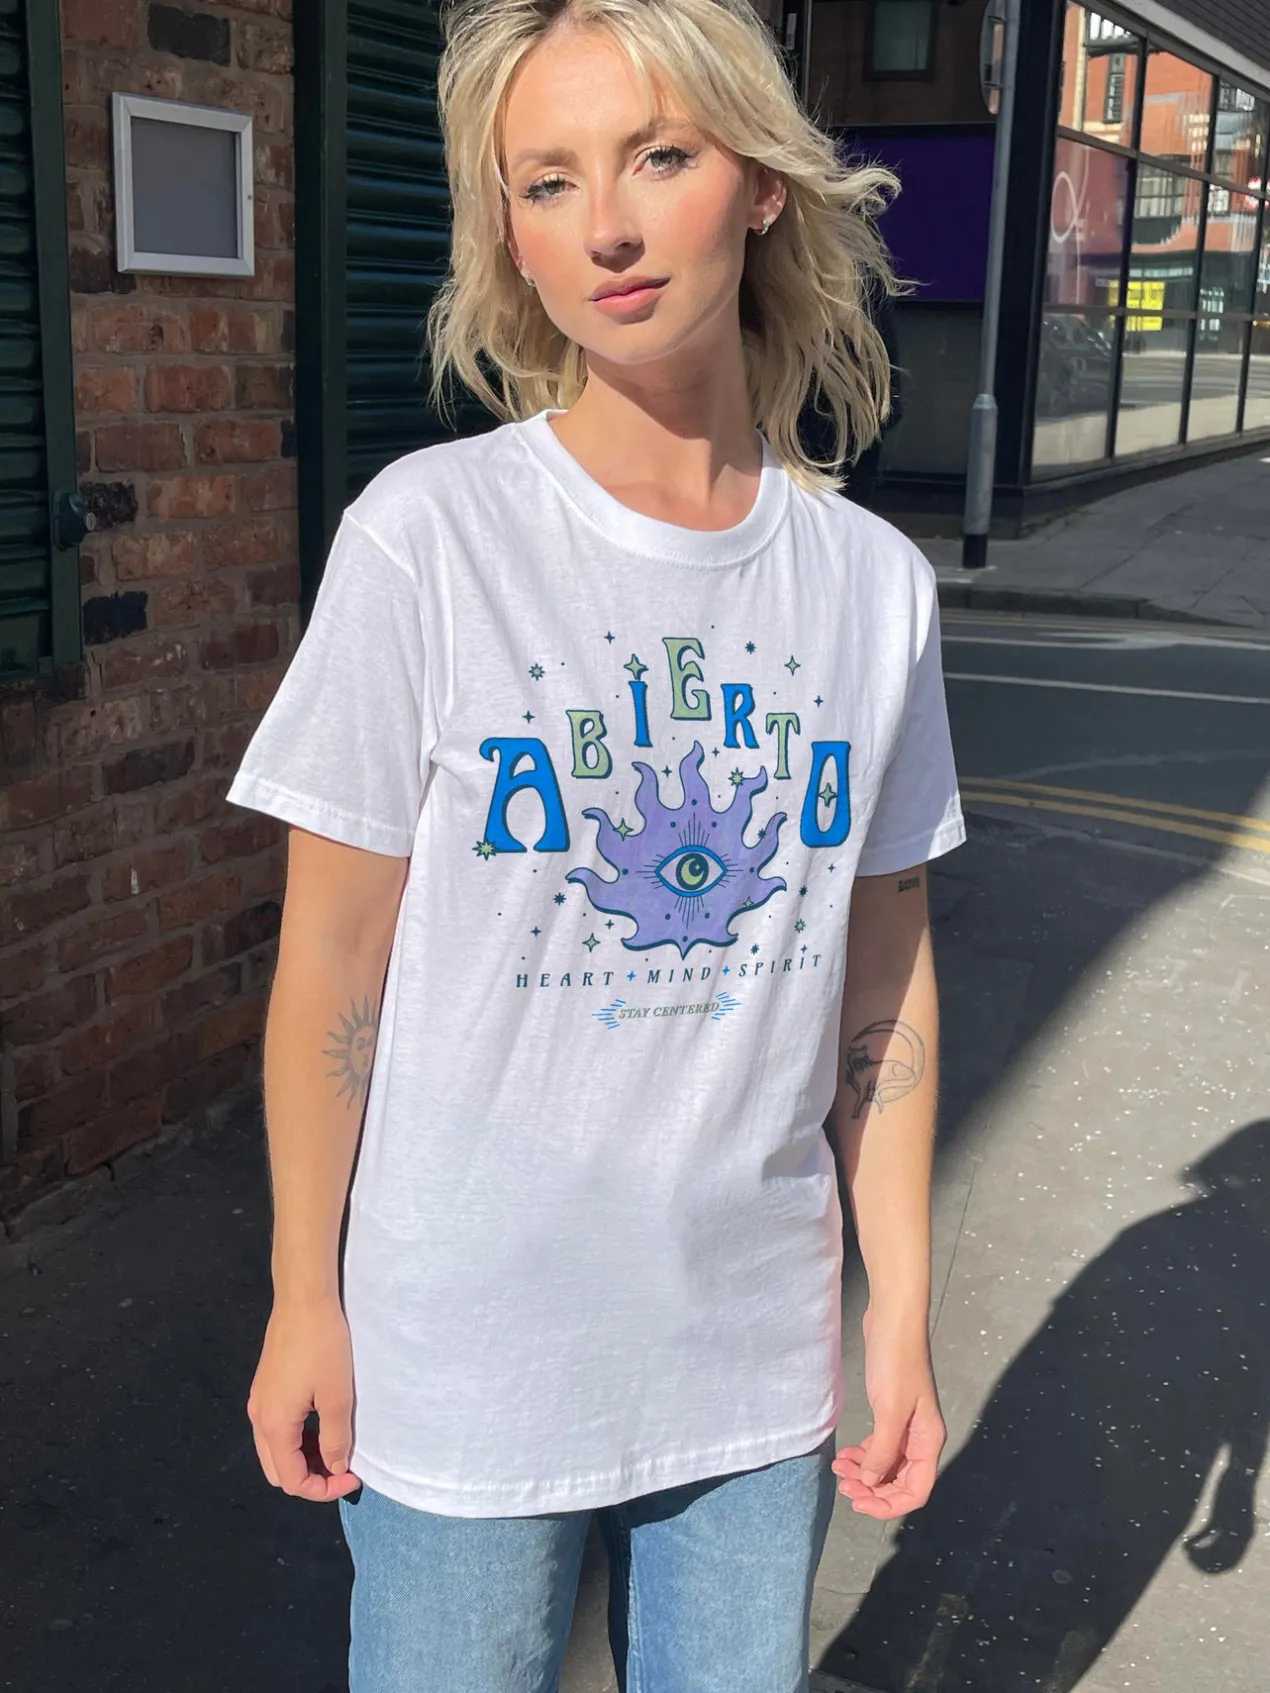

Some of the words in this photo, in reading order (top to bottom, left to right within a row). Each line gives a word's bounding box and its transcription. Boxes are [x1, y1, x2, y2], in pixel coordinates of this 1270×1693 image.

[516, 971, 614, 988] HEART
[647, 967, 711, 984] MIND
[738, 954, 821, 977] SPIRIT
[618, 1007, 650, 1020] STAY
[653, 1002, 720, 1017] CENTERED
